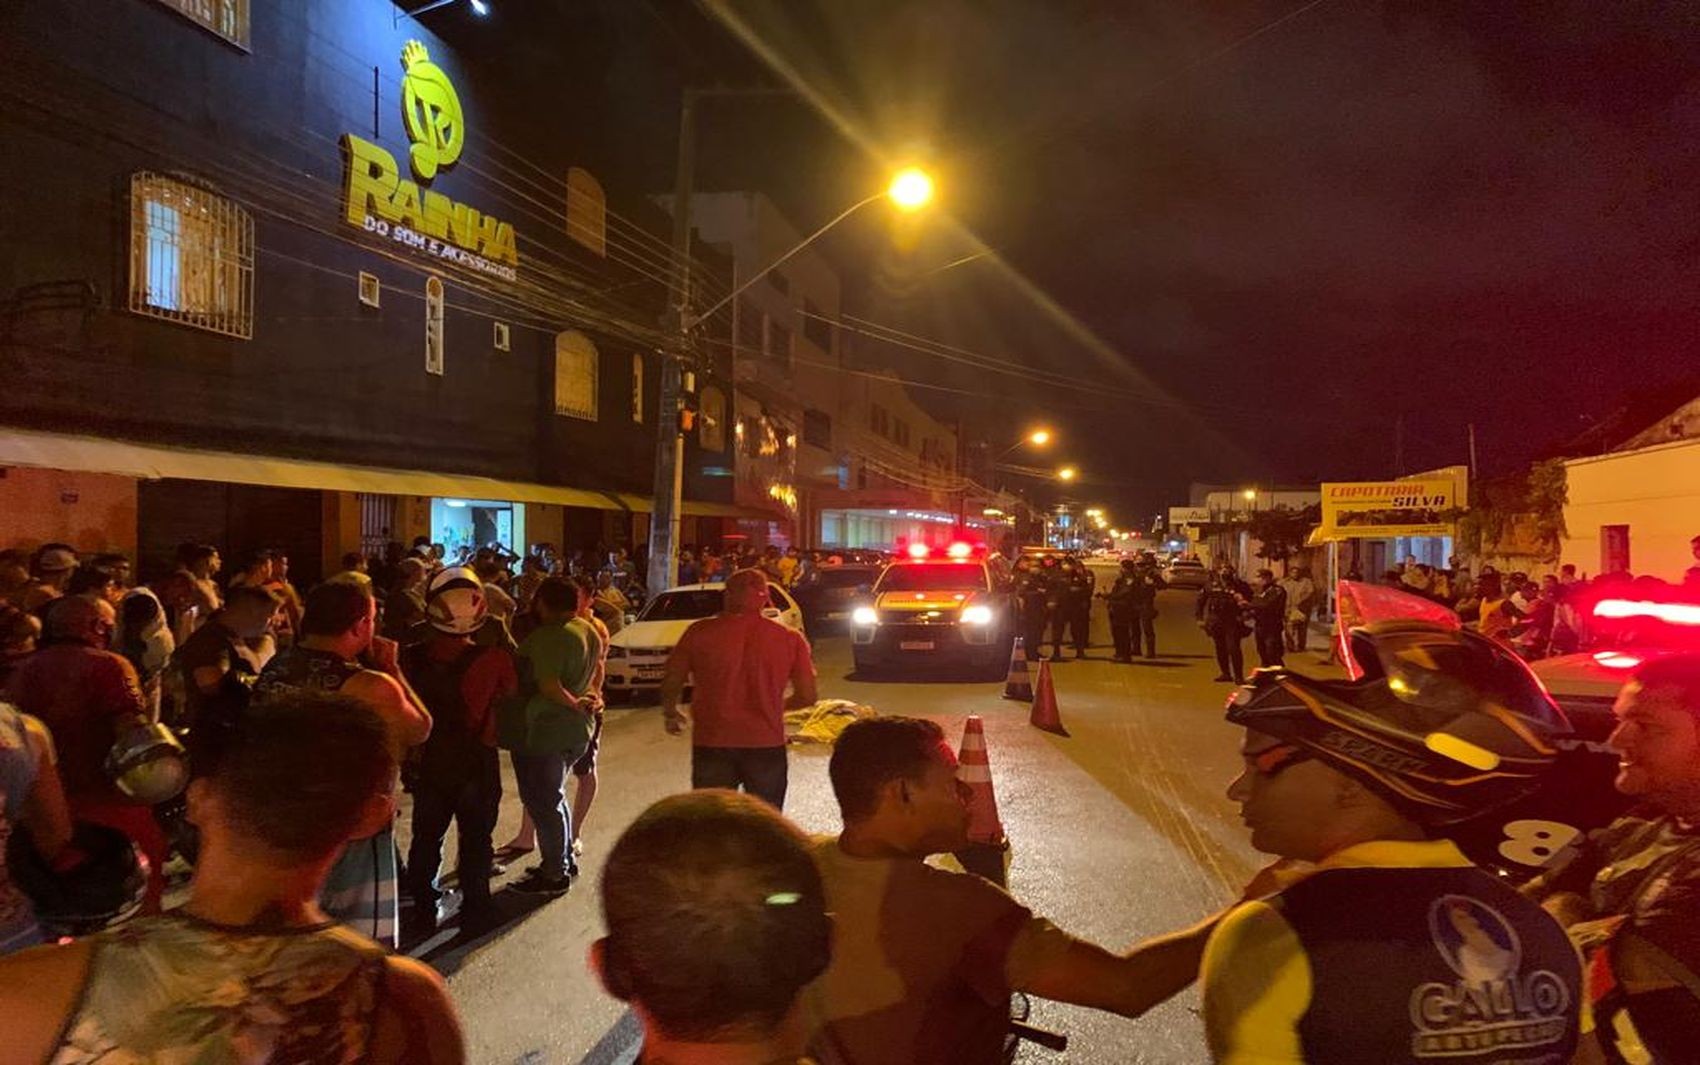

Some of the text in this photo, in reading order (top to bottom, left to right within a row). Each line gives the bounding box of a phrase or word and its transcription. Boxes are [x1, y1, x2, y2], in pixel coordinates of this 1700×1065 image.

[343, 133, 519, 267] RAINHA
[364, 215, 388, 236] DO
[393, 226, 425, 250] SOM
[428, 239, 439, 254] E
[1330, 485, 1424, 497] CAPOTARIA
[1392, 496, 1445, 507] SILVA
[1411, 971, 1568, 1031] GALLO
